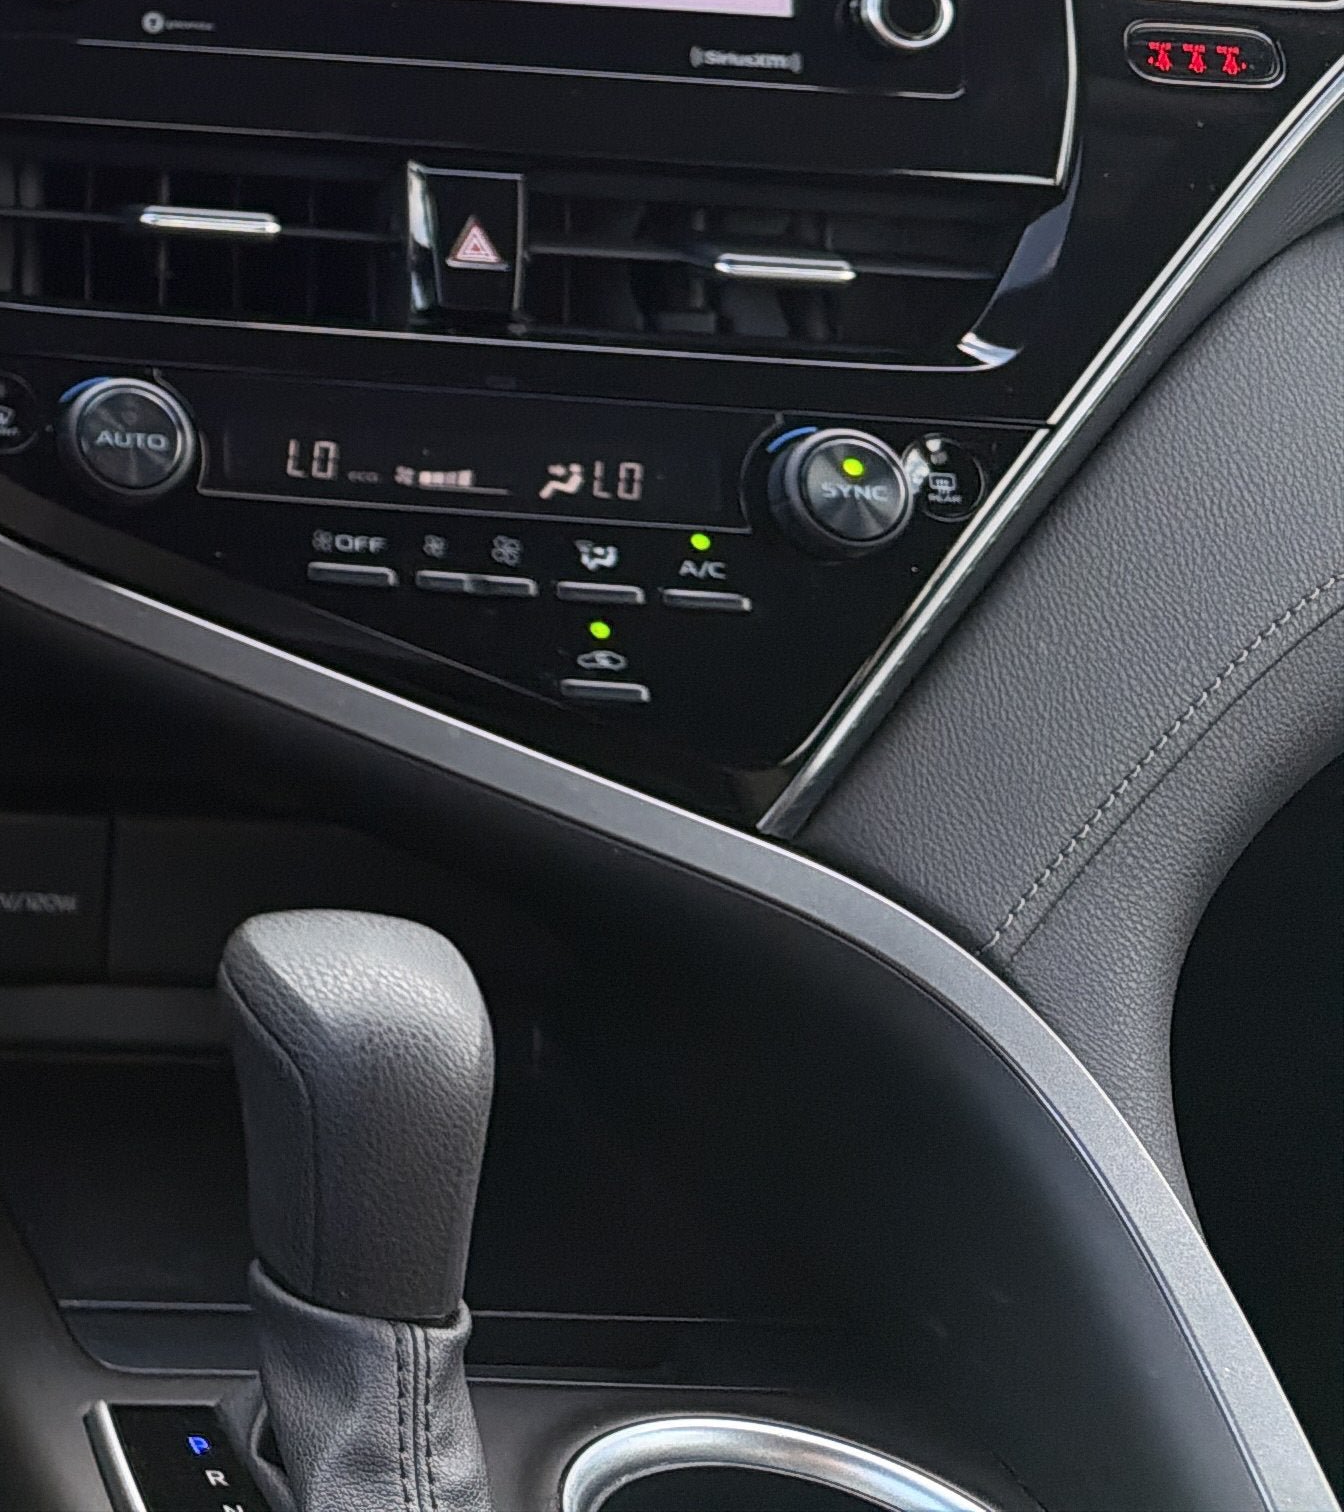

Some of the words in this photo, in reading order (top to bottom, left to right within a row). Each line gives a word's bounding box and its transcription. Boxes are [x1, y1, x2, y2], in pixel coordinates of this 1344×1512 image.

[95, 429, 169, 450] AUTO
[821, 481, 888, 502] SYNC
[335, 534, 387, 553] OFF
[678, 560, 727, 580] A/C
[187, 1436, 210, 1455] P
[205, 1469, 230, 1486] R
